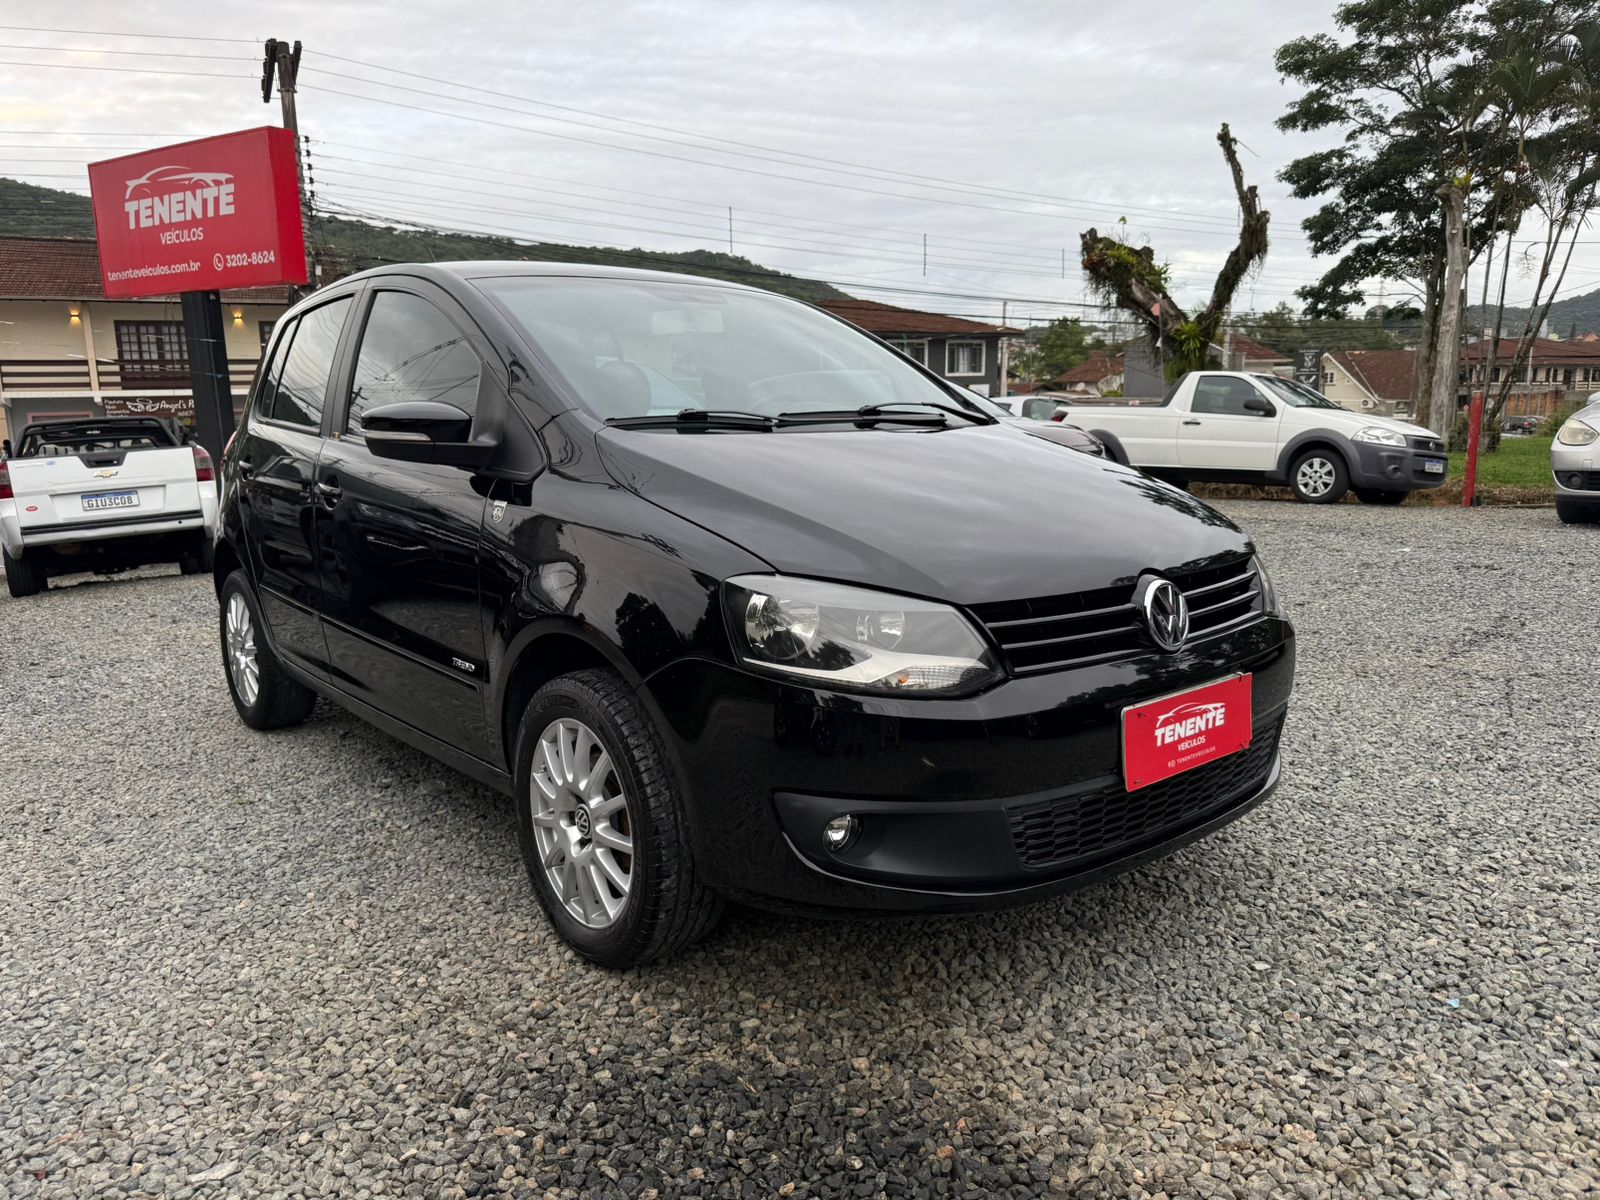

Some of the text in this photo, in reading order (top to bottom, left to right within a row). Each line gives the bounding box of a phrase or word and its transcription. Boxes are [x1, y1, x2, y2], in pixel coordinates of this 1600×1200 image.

[124, 183, 235, 229] TENENTE
[160, 226, 204, 245] VEÍCULOS
[225, 250, 276, 268] 3202-8624
[87, 495, 133, 509] GIU3C08
[1154, 707, 1226, 747] TENENTE
